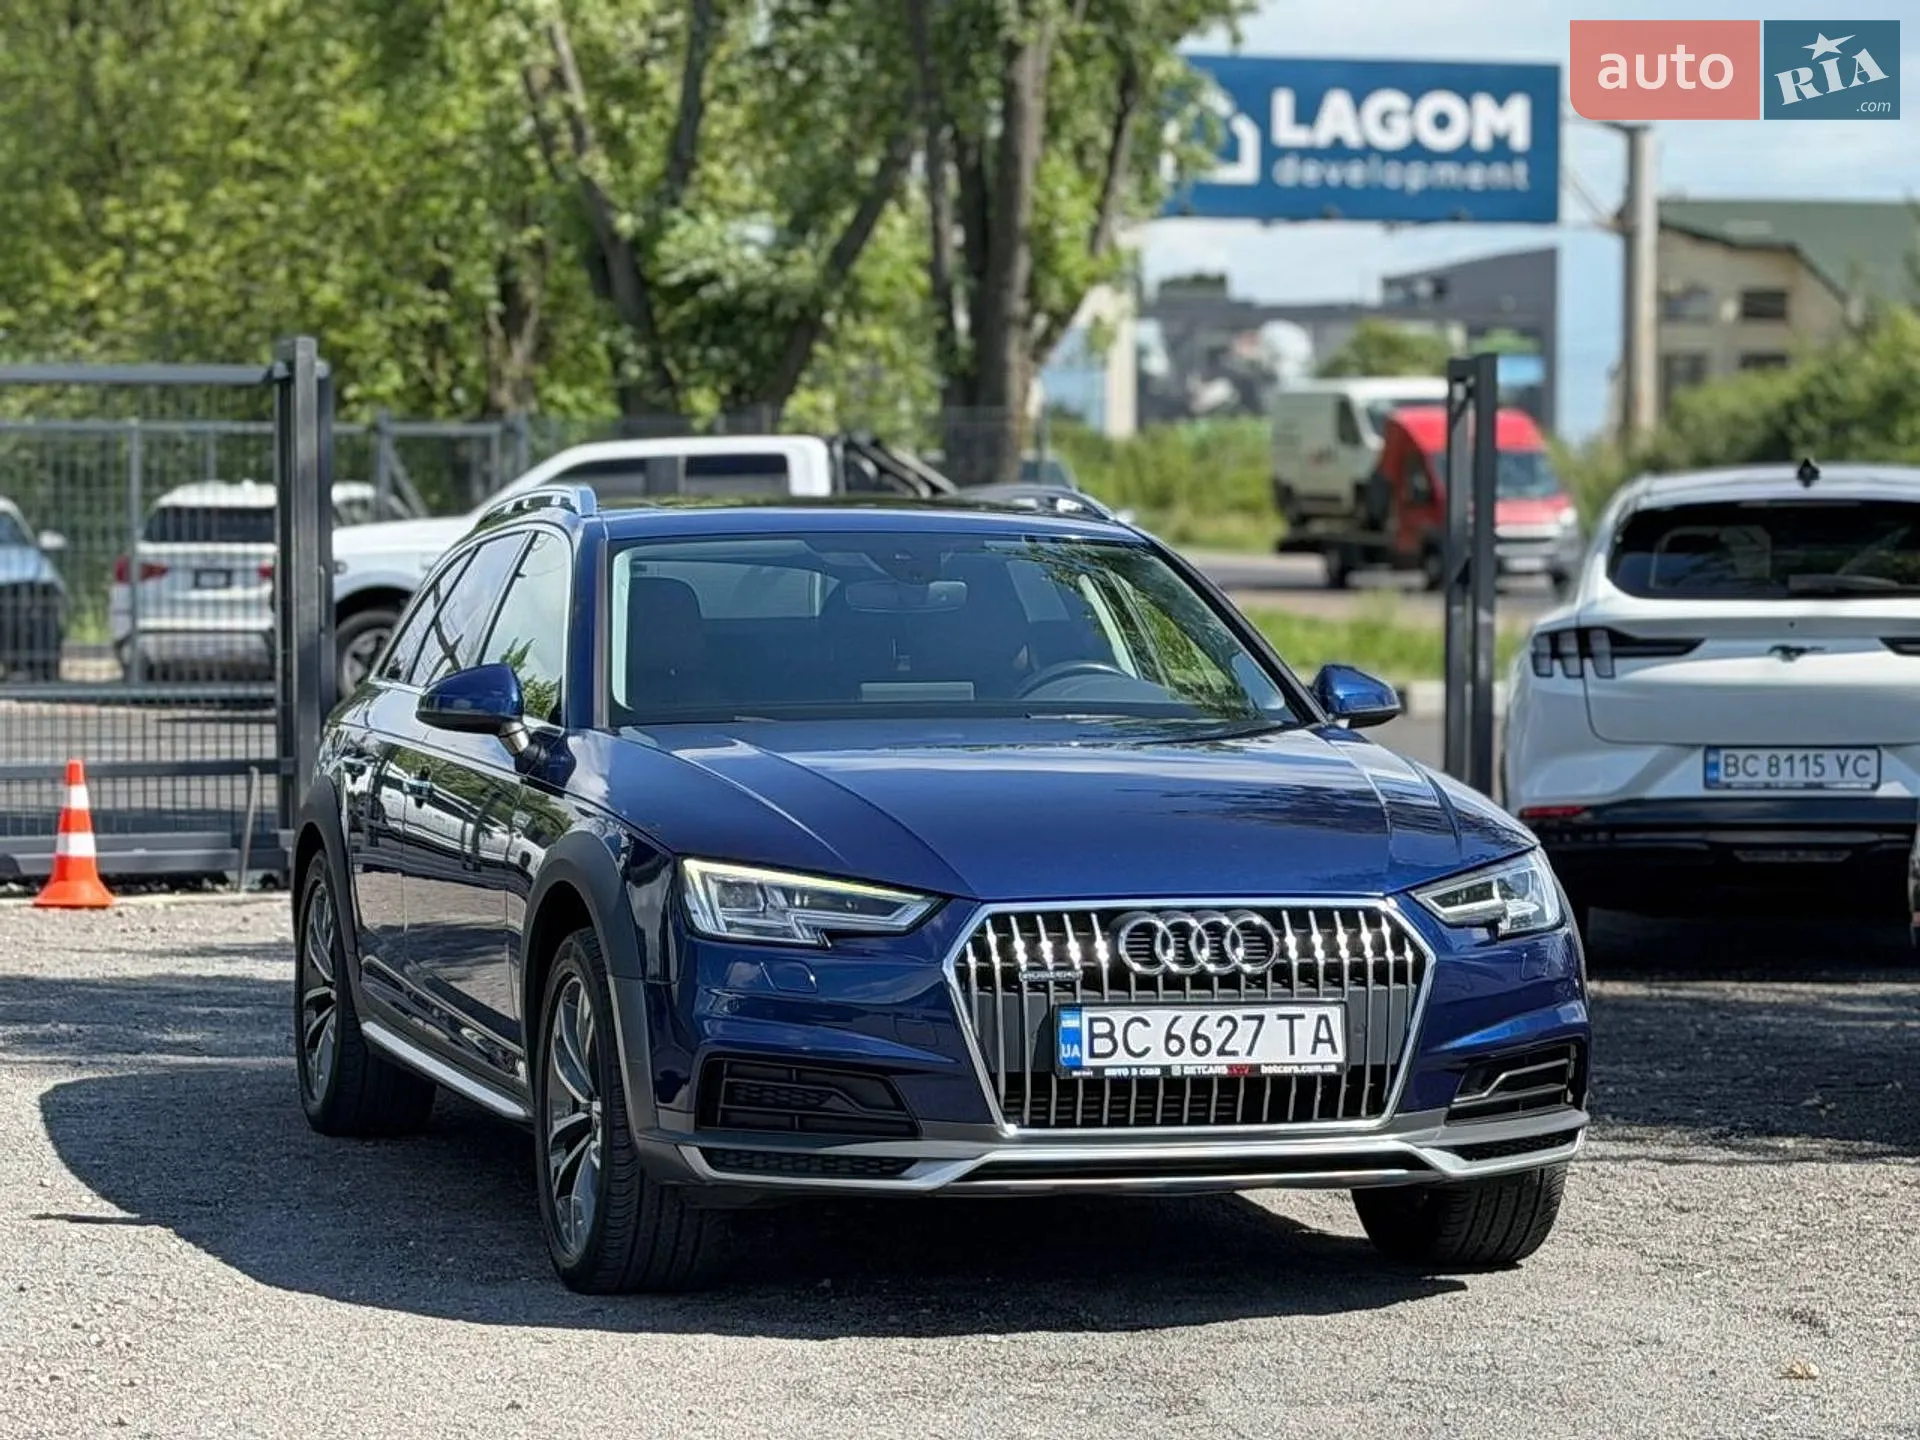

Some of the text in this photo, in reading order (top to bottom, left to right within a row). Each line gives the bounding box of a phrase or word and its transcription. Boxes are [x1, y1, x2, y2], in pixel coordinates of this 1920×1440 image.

[1270, 86, 1532, 152] LAGOM
[1271, 152, 1530, 194] development
[1723, 753, 1871, 778] BC 8115 YC
[1061, 1043, 1081, 1058] UA
[1087, 1013, 1338, 1059] BC 6627 TA
